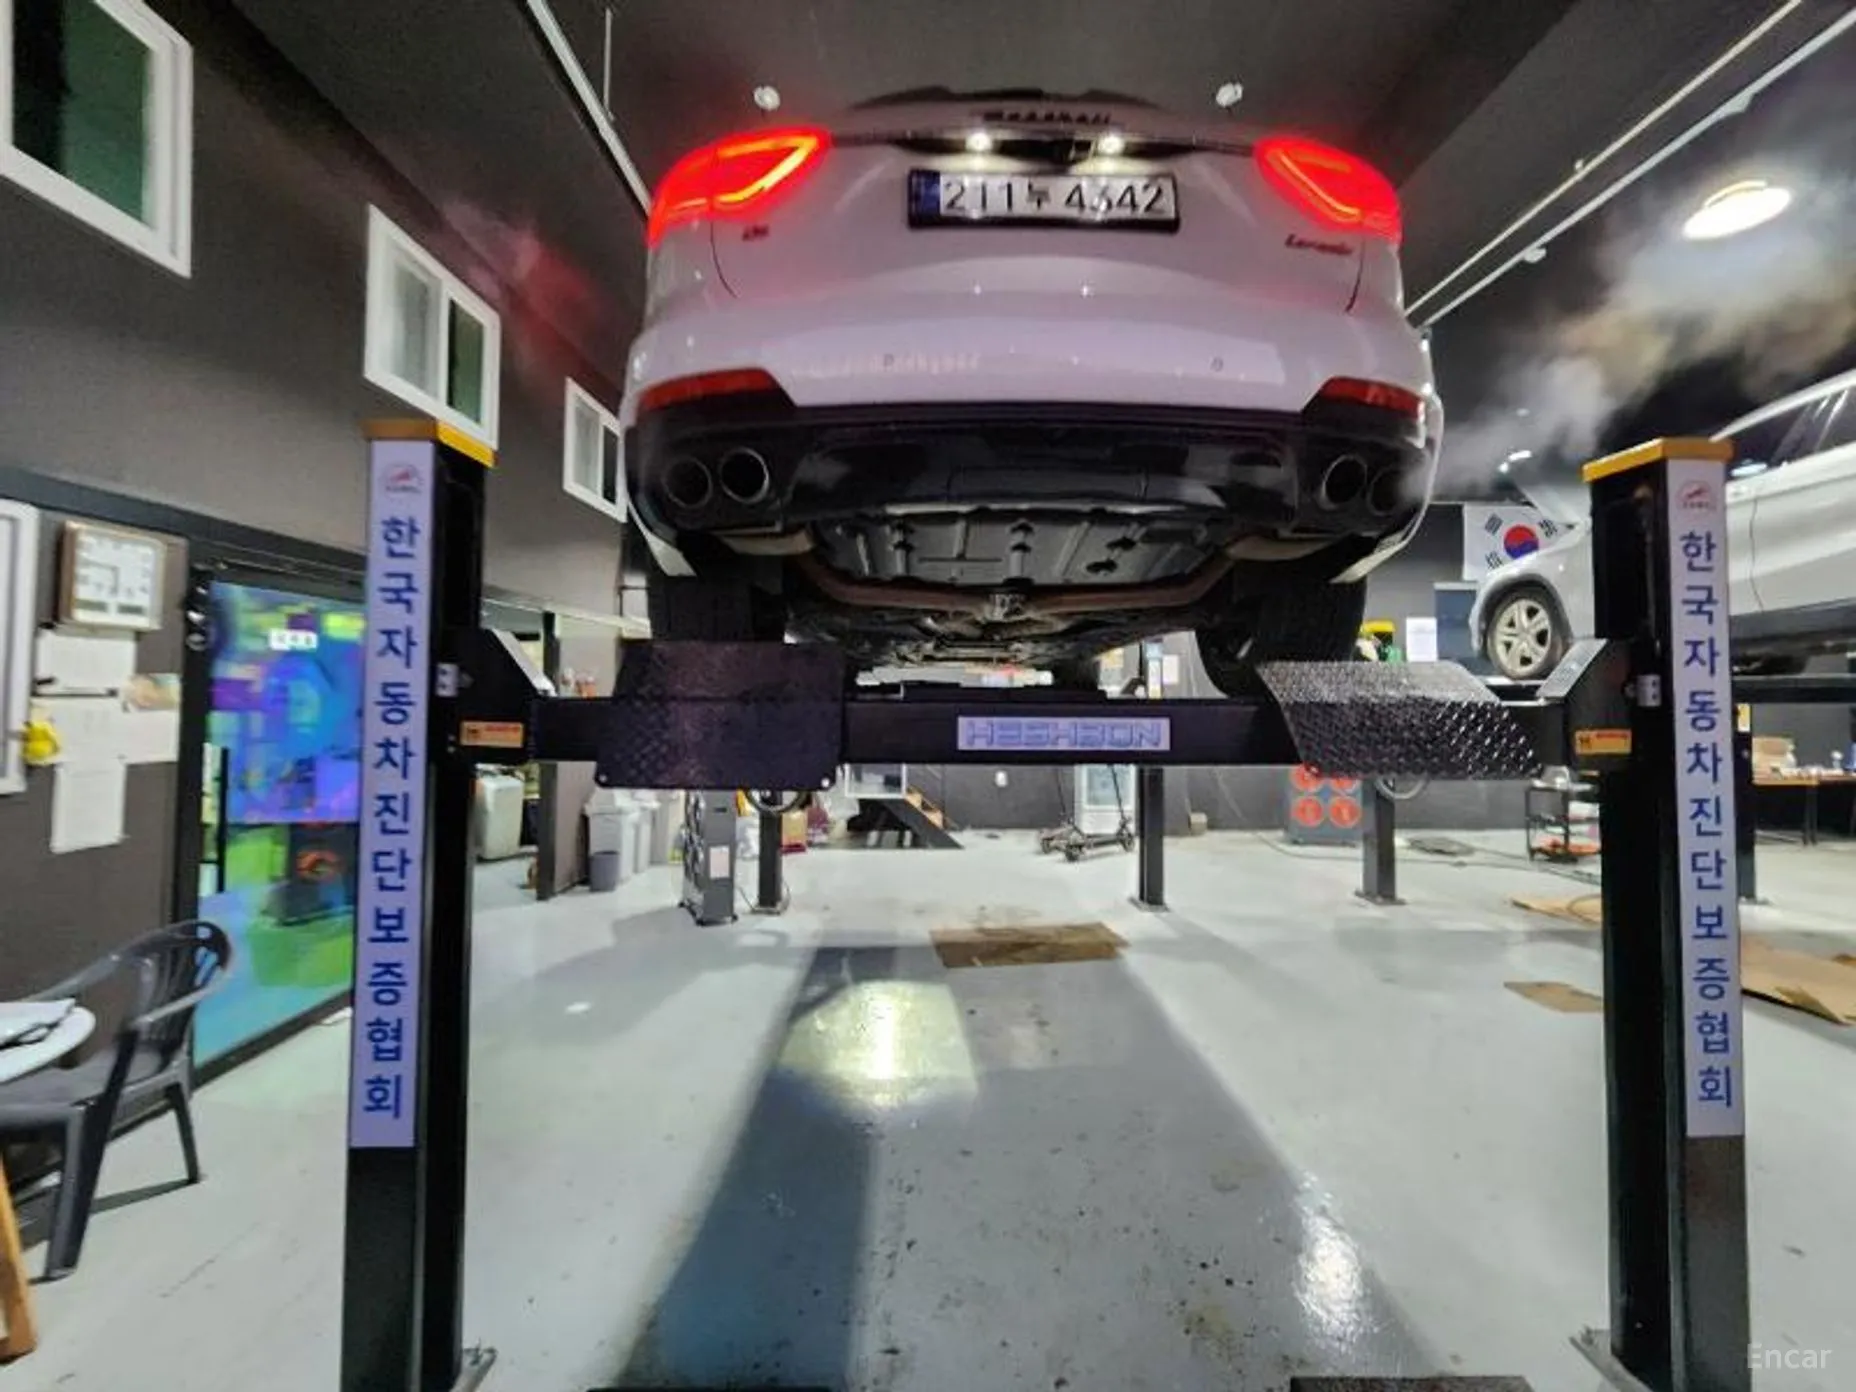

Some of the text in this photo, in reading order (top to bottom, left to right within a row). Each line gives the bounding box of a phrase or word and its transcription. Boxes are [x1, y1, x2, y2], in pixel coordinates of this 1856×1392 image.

[363, 515, 421, 1119] 한국자동차진단보증협회
[966, 720, 1163, 748] HESHBON
[1679, 530, 1731, 1108] 한국자동차진단보증협회
